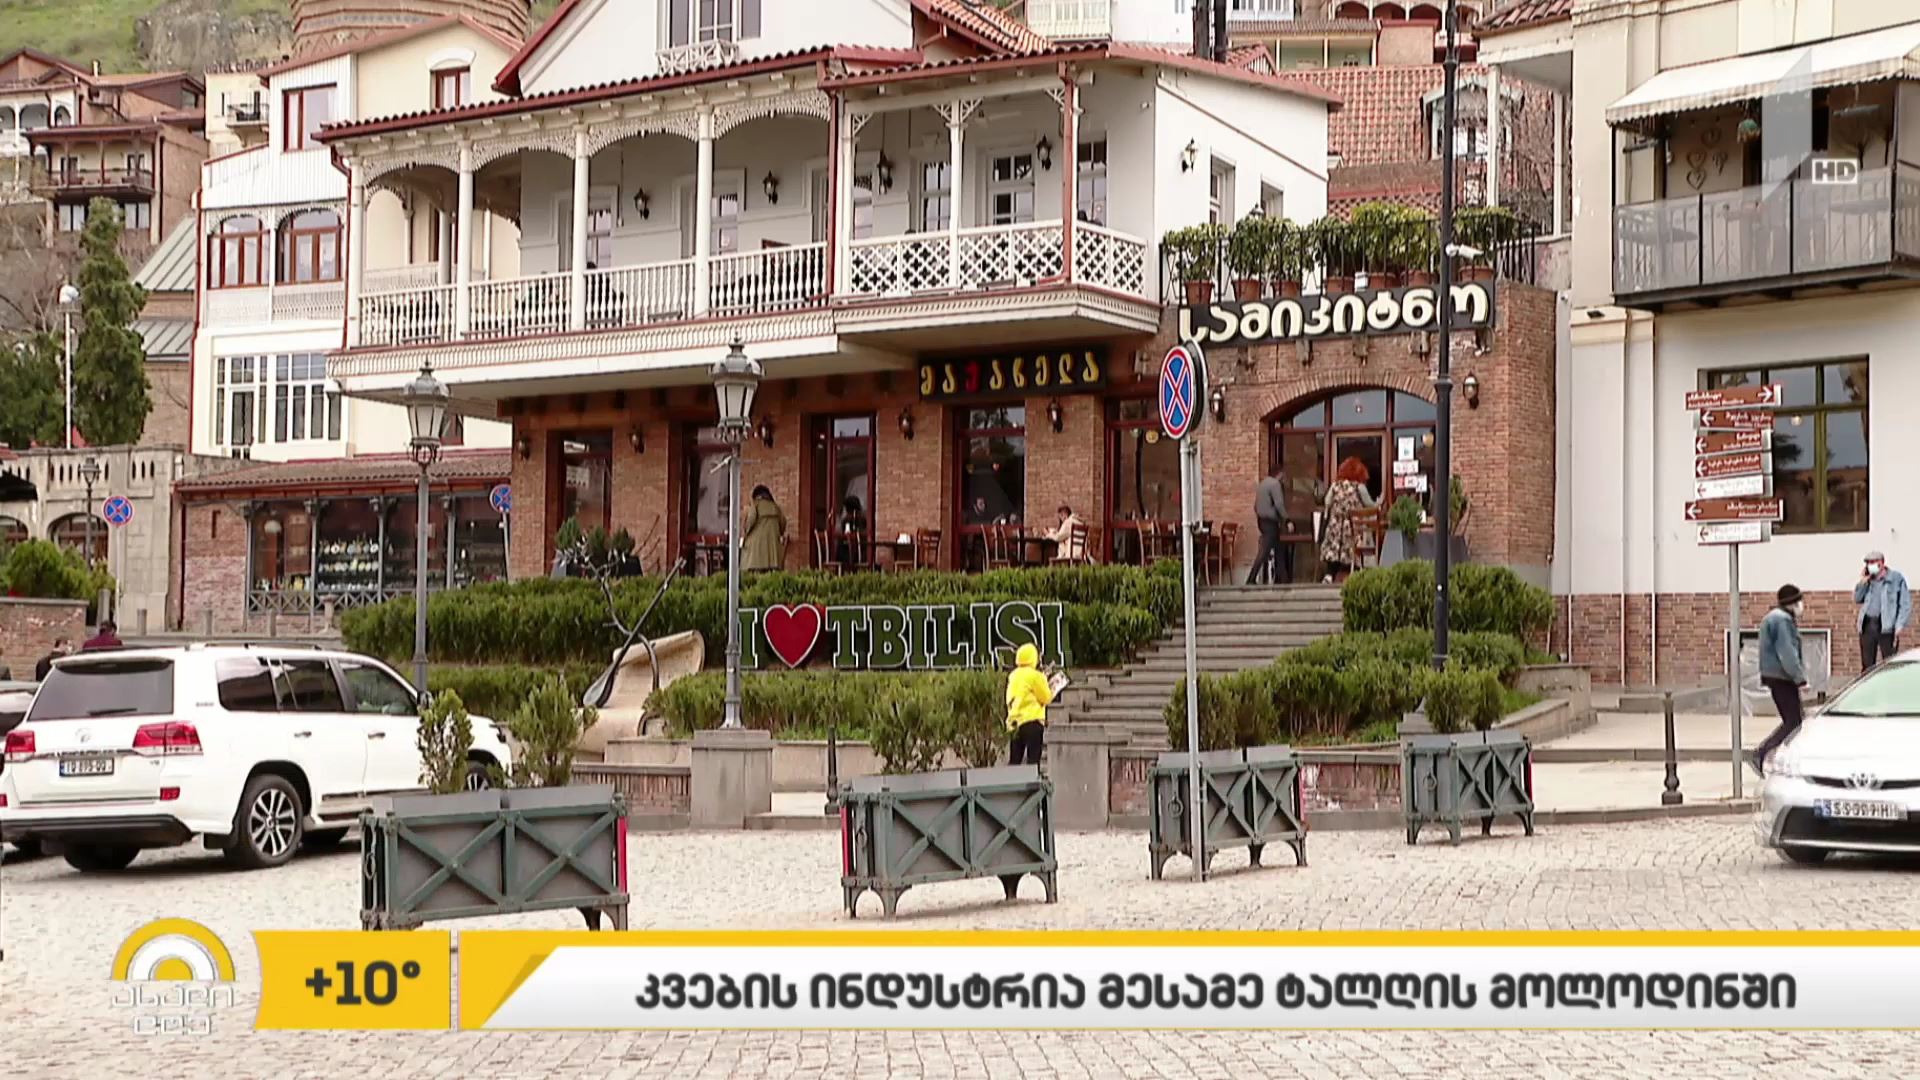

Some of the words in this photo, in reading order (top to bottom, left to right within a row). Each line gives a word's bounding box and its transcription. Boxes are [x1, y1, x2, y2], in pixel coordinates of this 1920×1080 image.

[1179, 283, 1489, 343] სამიკიტნო
[737, 607, 758, 668] I
[825, 601, 1066, 669] TBILISI
